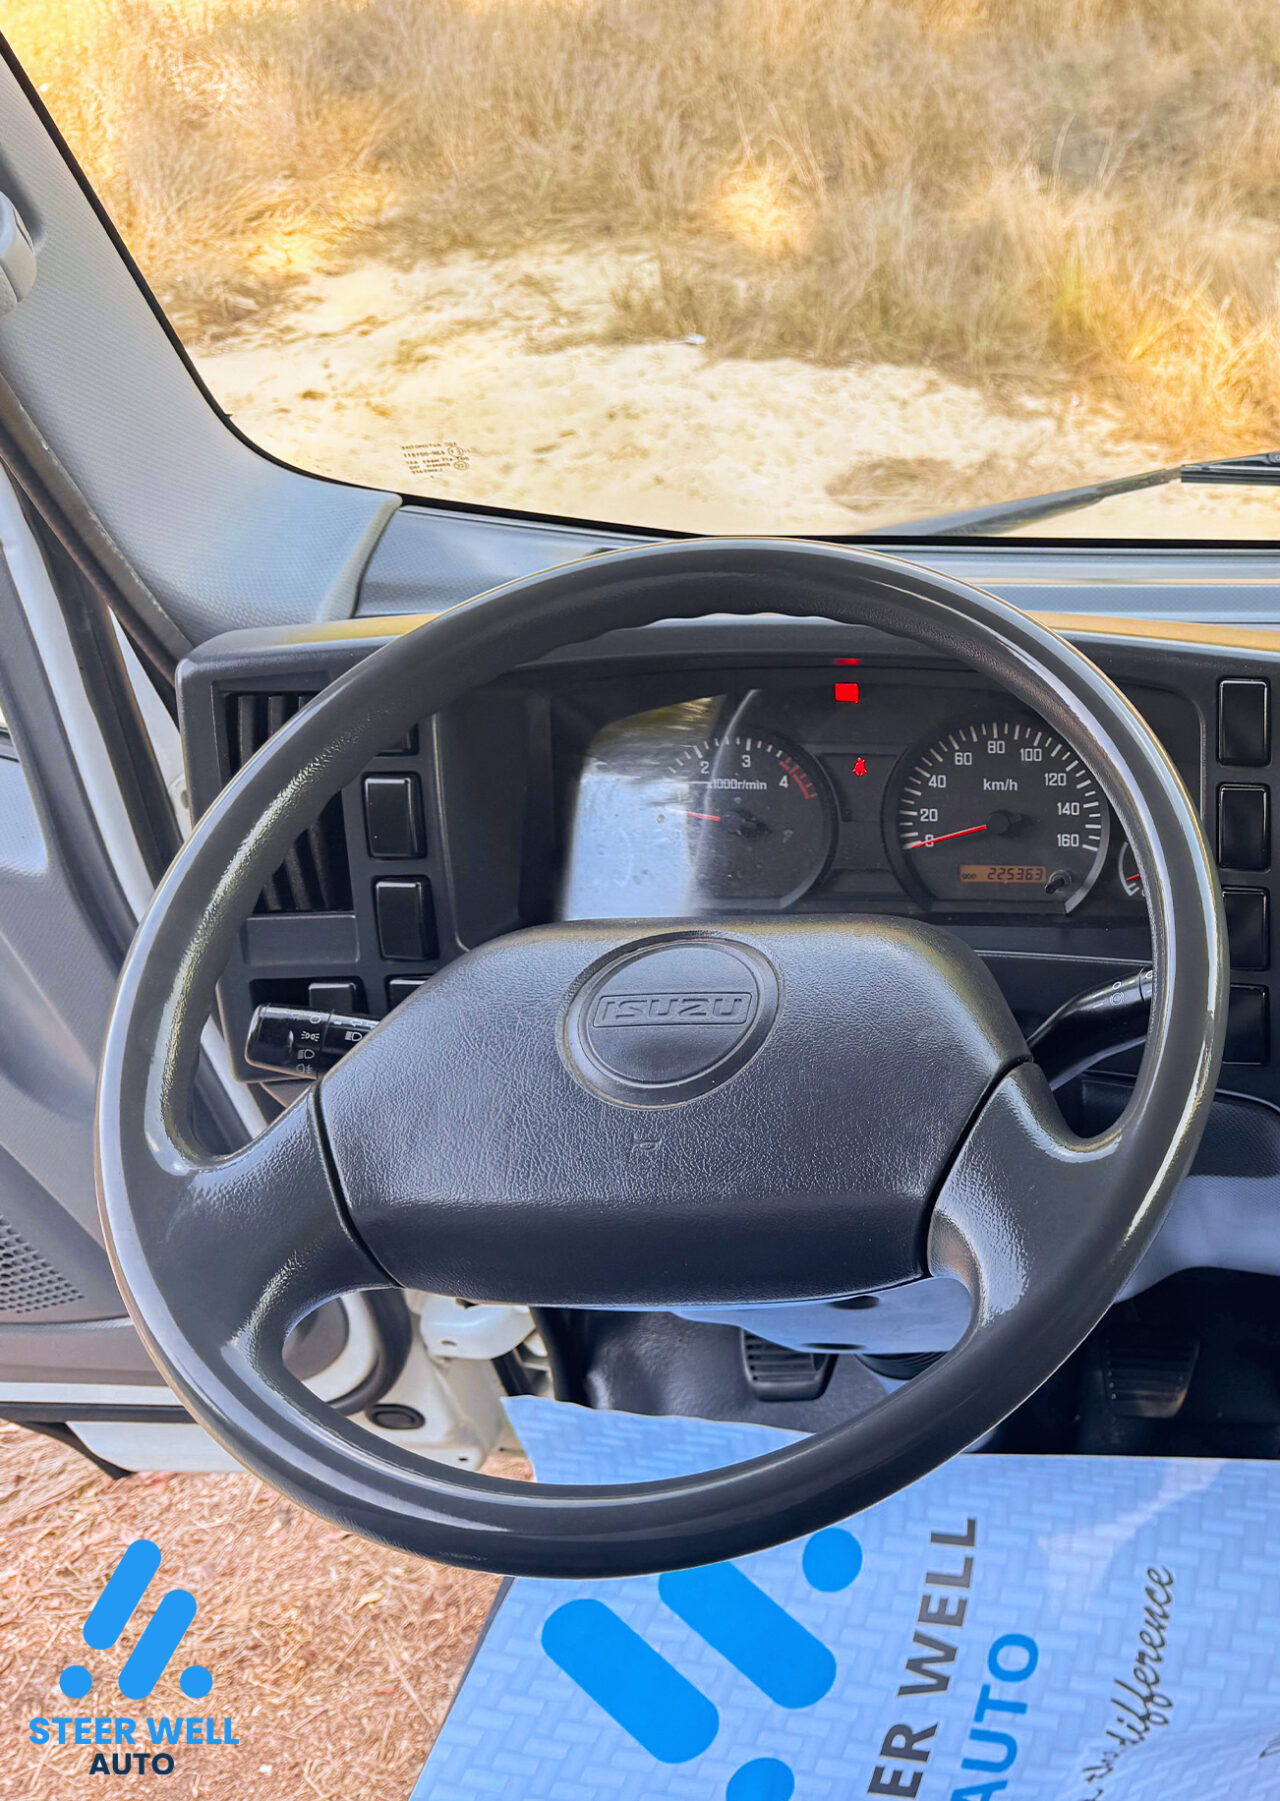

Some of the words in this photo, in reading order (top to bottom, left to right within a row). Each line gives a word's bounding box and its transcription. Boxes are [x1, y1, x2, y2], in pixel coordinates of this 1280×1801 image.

[987, 740, 1006, 754] 80
[741, 754, 751, 768] 3
[954, 752, 973, 765] 60
[1020, 748, 1042, 762] 100
[700, 760, 710, 775] 2
[778, 775, 789, 788] 4
[928, 775, 947, 788] 40
[983, 778, 1018, 791] km/h
[1044, 773, 1067, 786] 120
[920, 809, 938, 822] 20
[1057, 802, 1080, 816] 140
[925, 834, 934, 848] 0
[1057, 834, 1080, 847] 160
[987, 867, 1043, 880] 225363
[601, 997, 742, 1022] ISUZU
[897, 1517, 977, 1697] WELL
